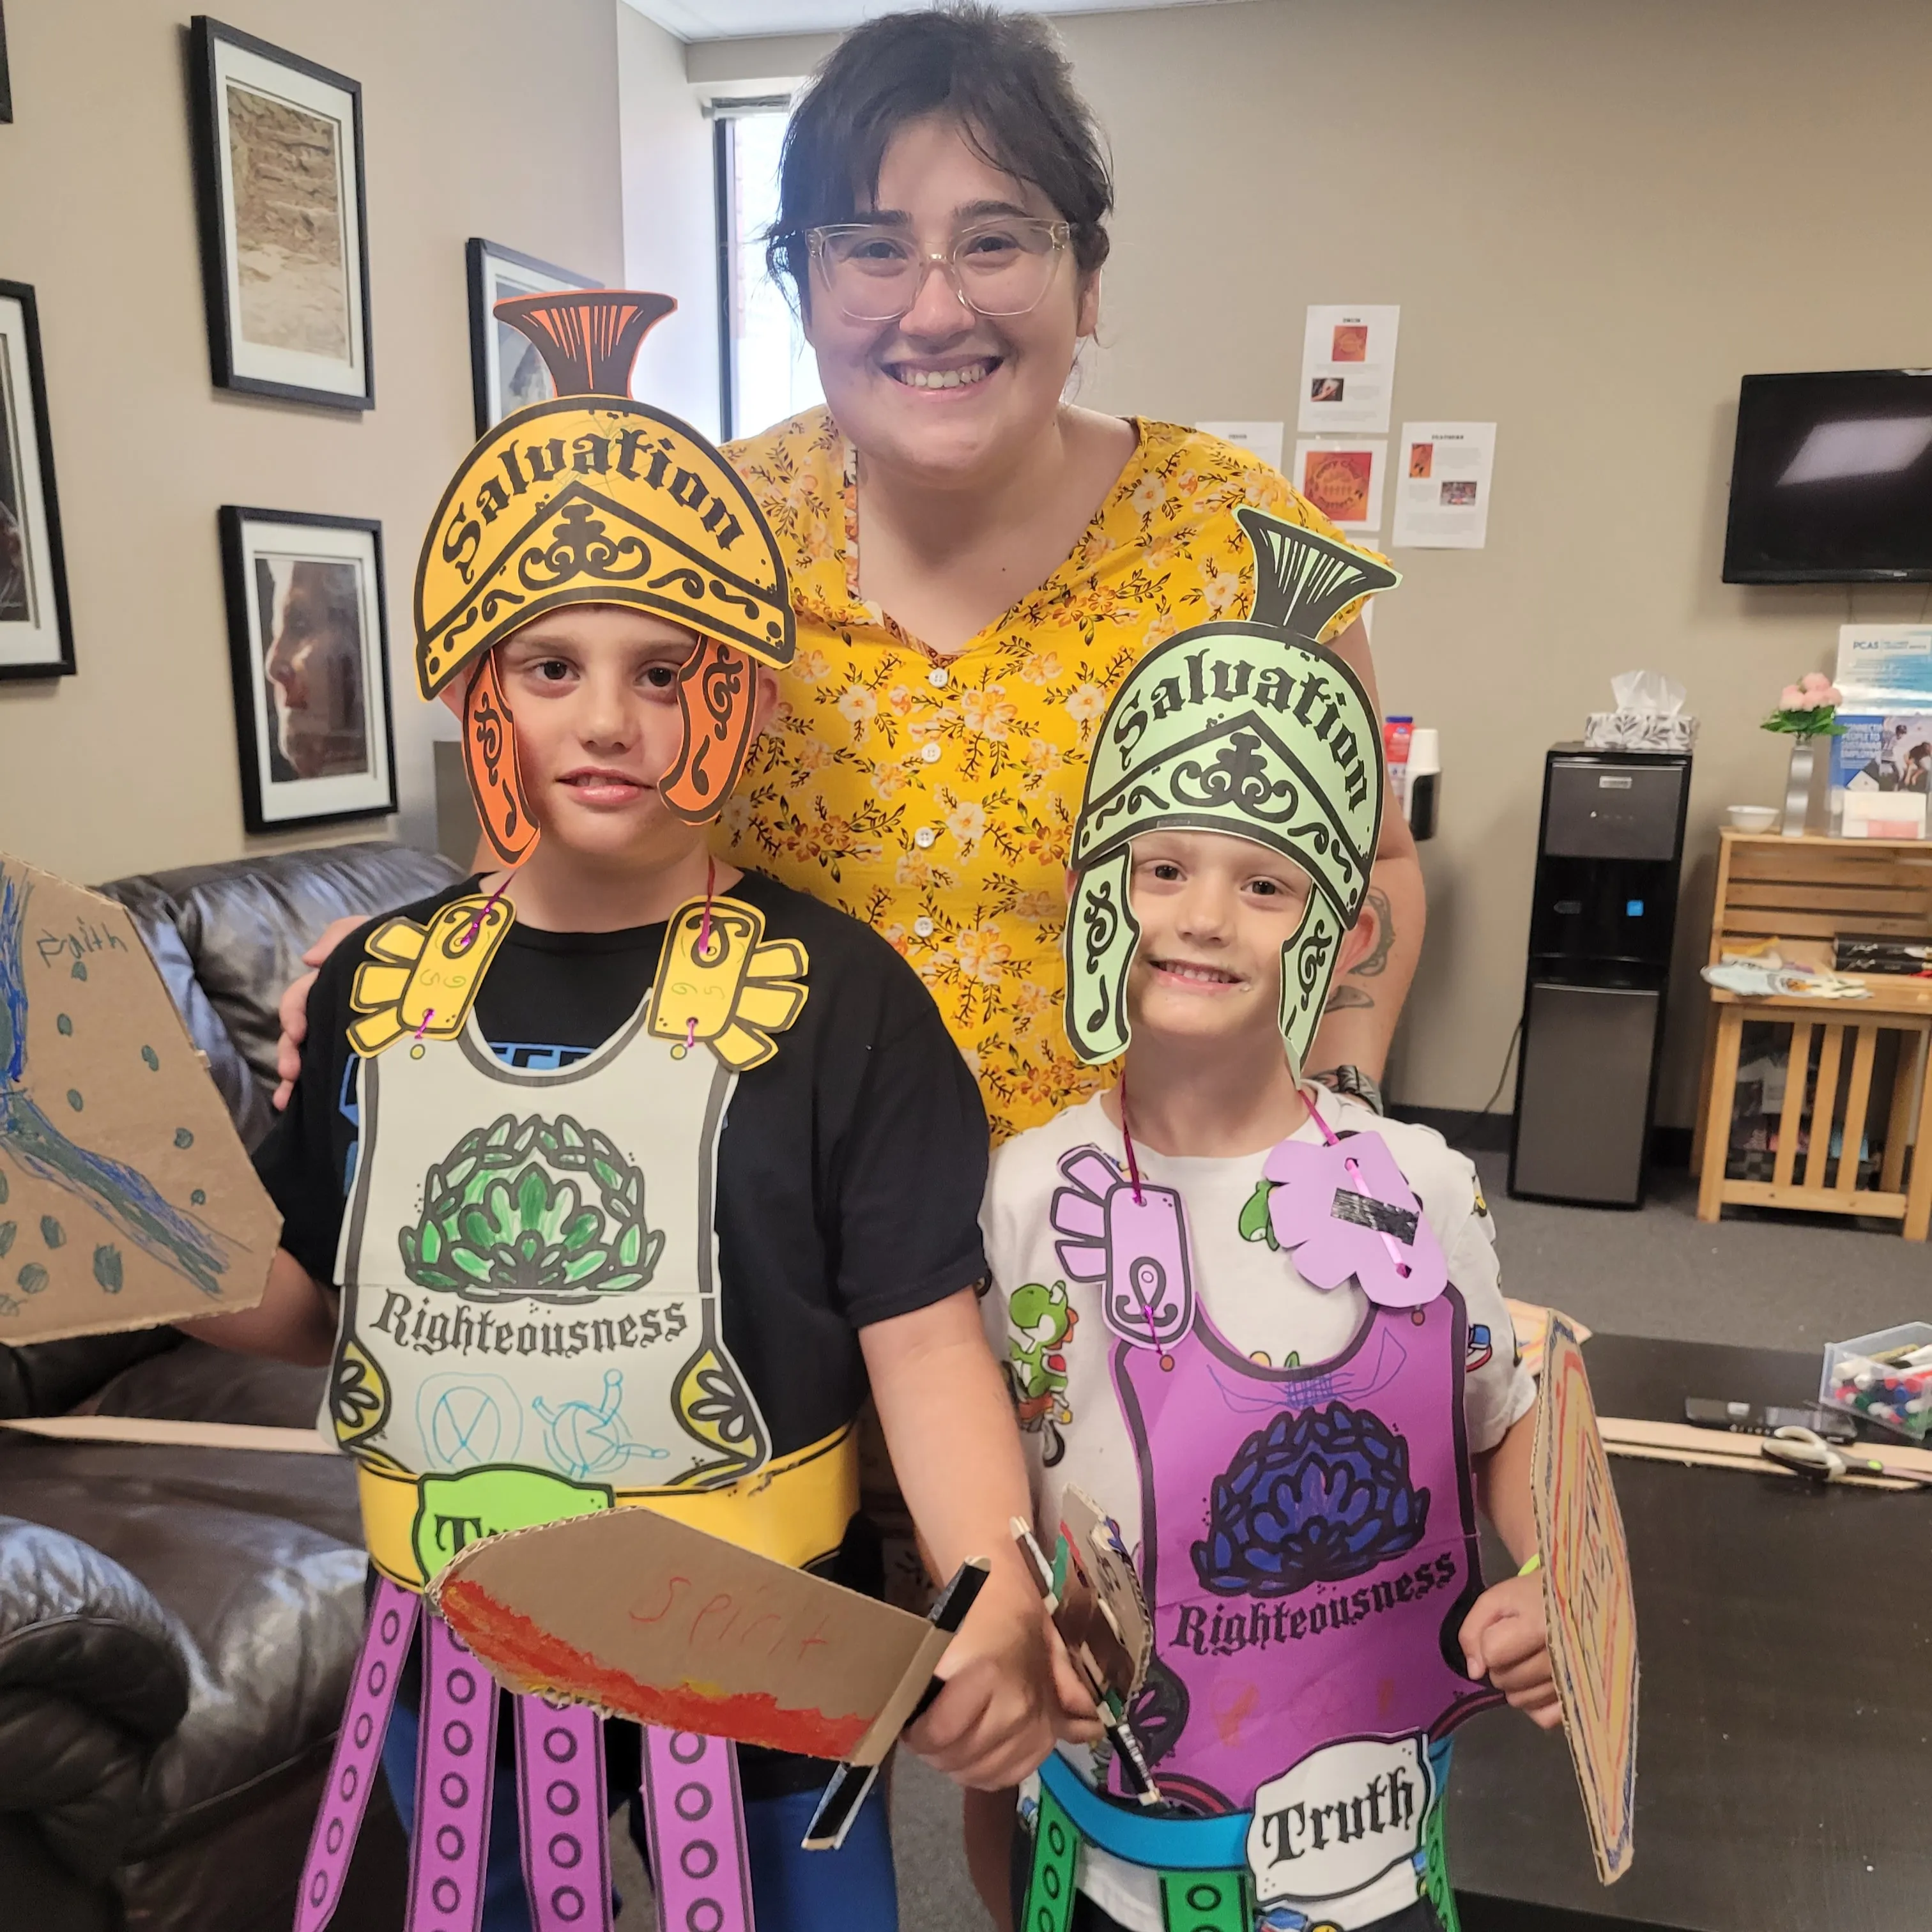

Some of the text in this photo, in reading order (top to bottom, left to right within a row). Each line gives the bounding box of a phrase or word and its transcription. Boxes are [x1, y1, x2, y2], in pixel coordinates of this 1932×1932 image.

[442, 429, 745, 585] Salvation
[1853, 641, 1879, 650] PCAS
[1113, 648, 1368, 814] Salvation
[369, 1287, 688, 1357] Righteousness
[628, 1577, 829, 1661] Spirit
[1169, 1551, 1457, 1656] Righteousness
[1262, 1767, 1414, 1869] Truth
